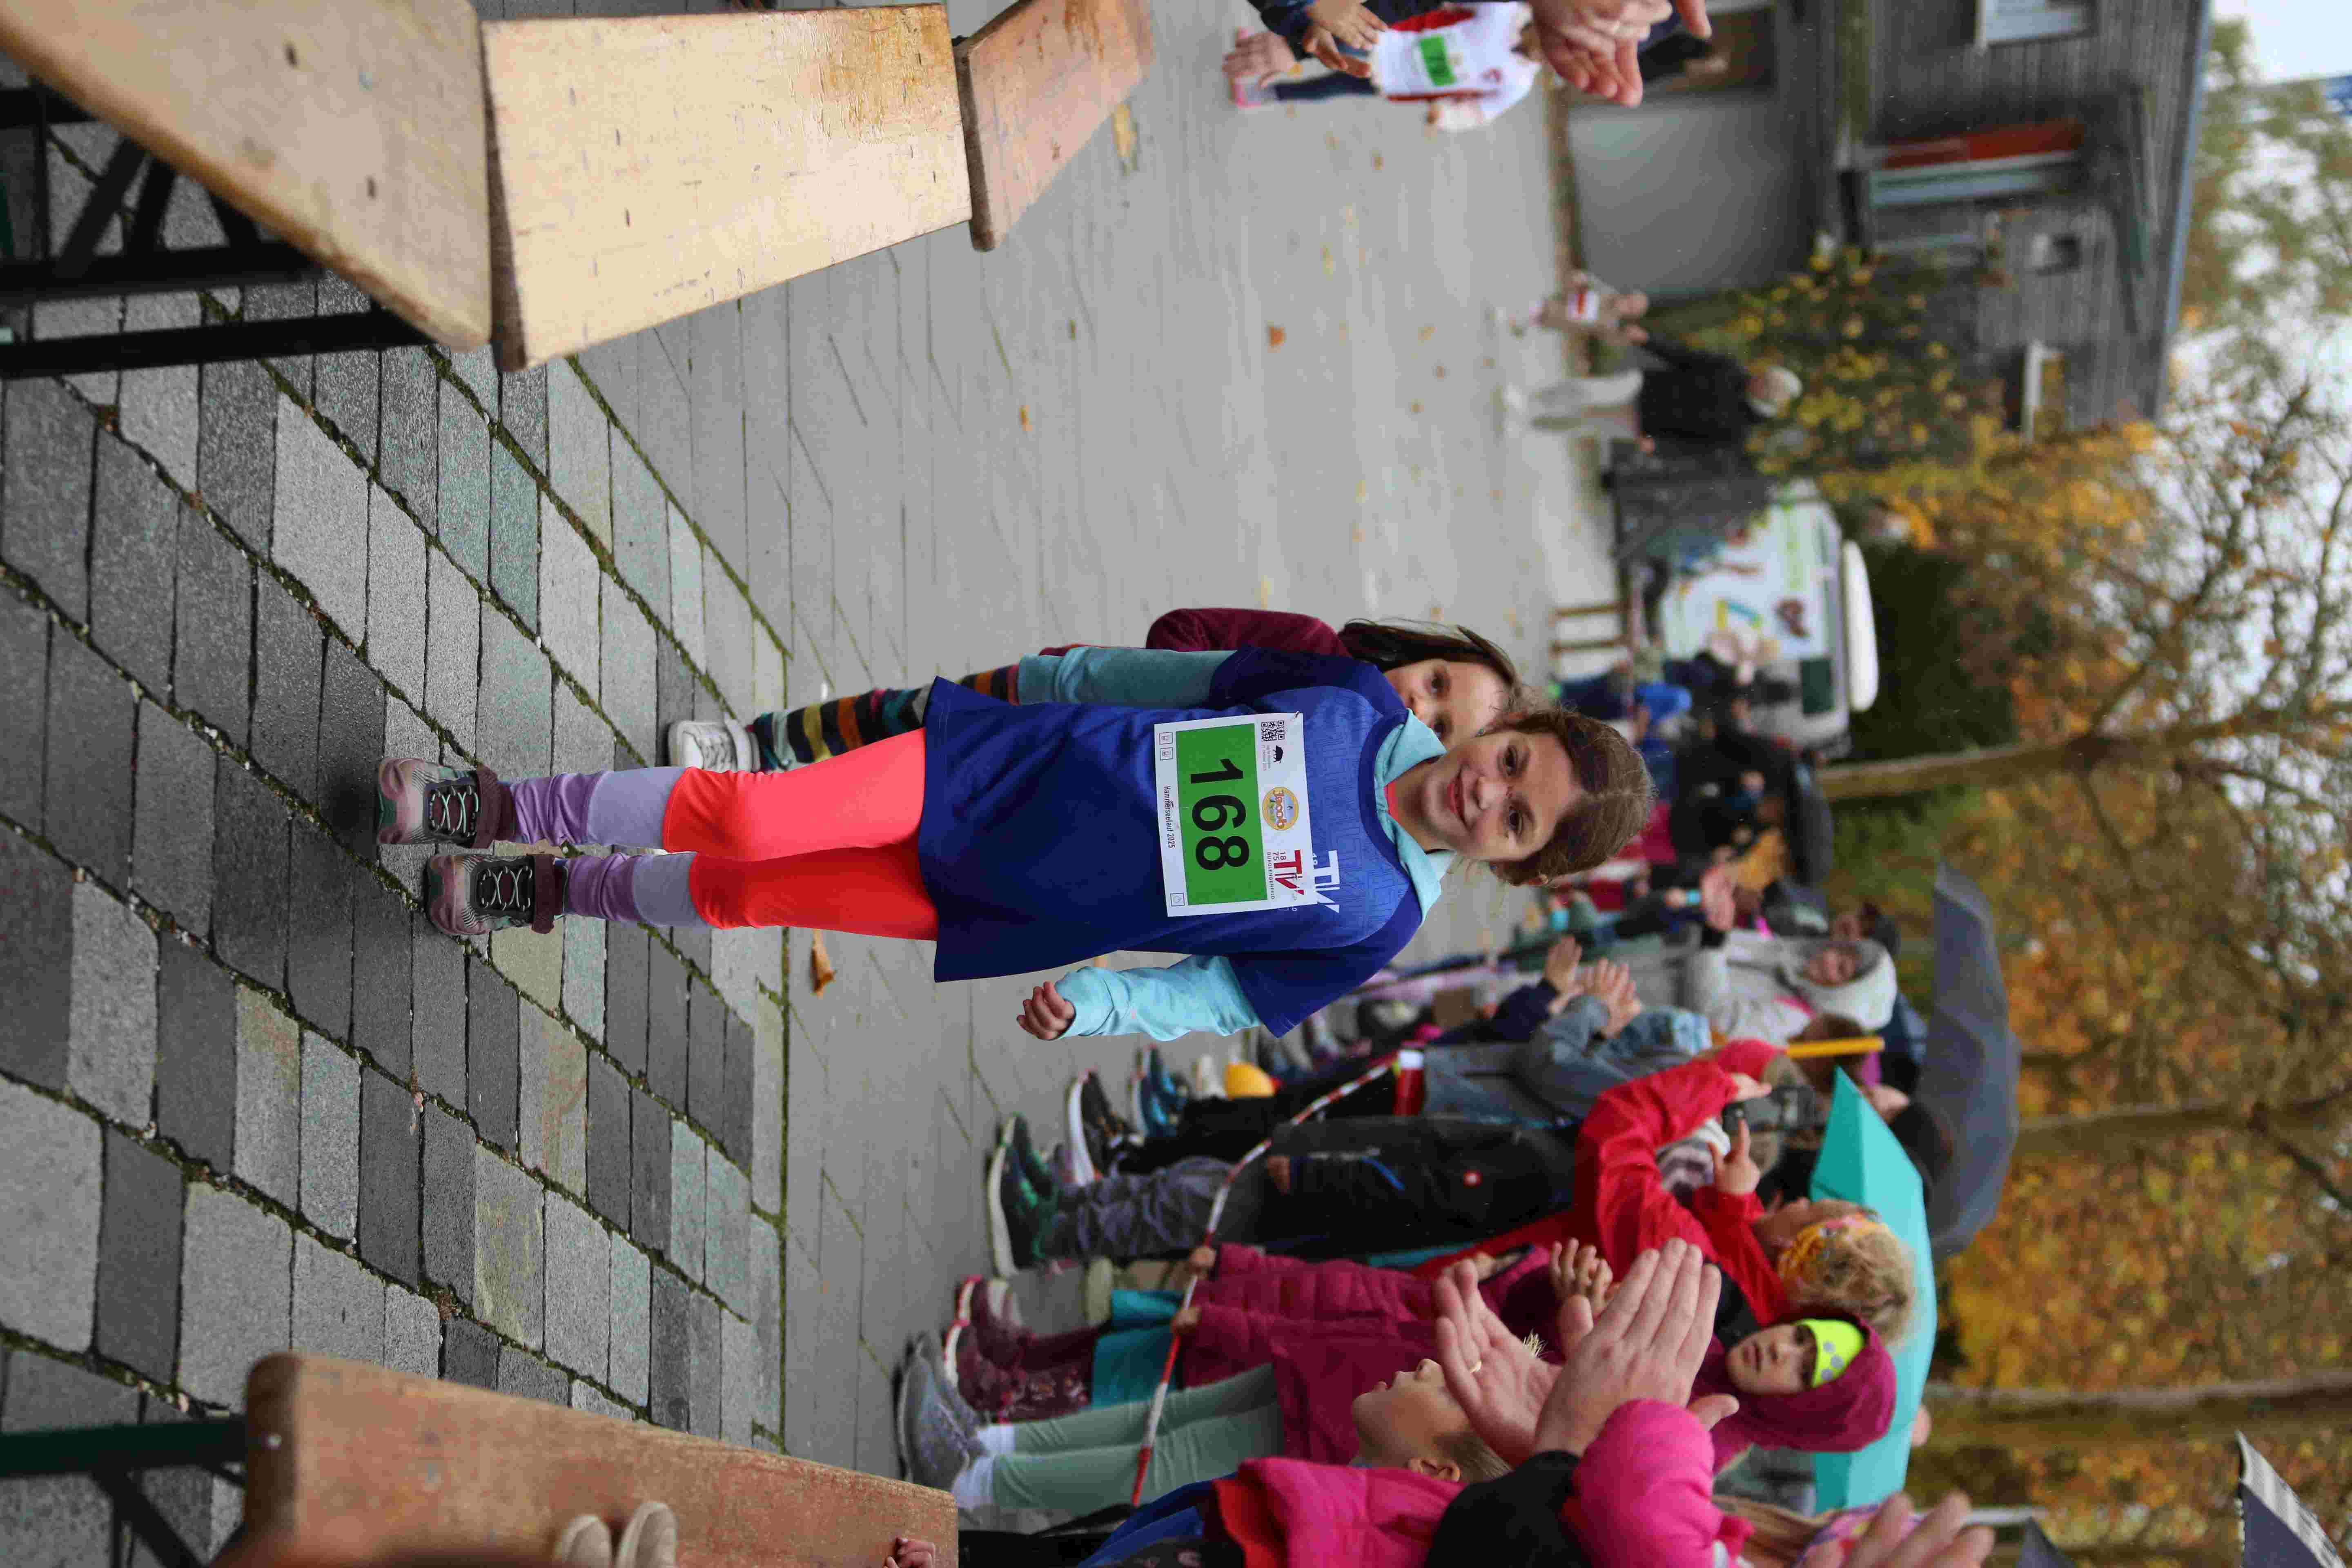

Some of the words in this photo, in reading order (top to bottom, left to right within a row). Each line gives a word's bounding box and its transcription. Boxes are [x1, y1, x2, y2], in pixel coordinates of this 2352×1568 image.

[1164, 786, 1174, 832] Hammerseelauf
[1190, 758, 1250, 871] 168
[1167, 833, 1176, 849] 2025
[1273, 851, 1279, 861] 75
[1279, 851, 1286, 860] 18
